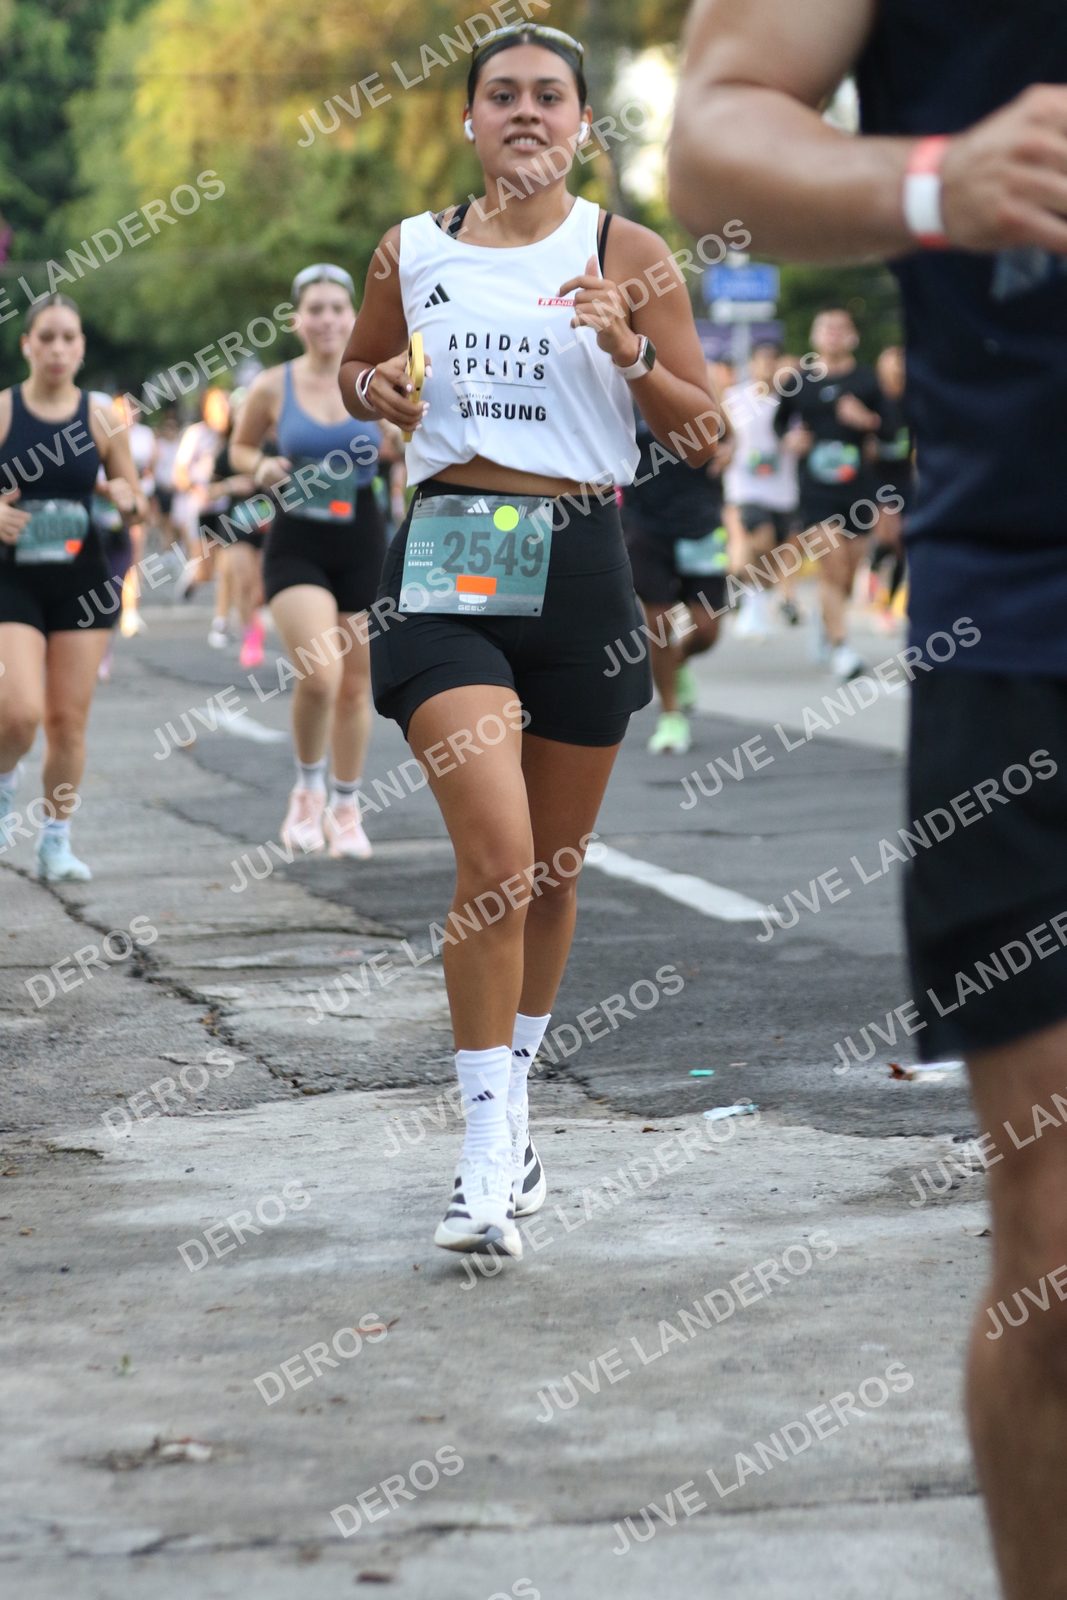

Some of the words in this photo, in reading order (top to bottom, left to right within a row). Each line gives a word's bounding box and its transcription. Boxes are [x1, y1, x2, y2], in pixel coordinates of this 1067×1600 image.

[449, 332, 550, 356] ADIDAS
[453, 358, 545, 380] SPLITS
[459, 400, 547, 421] SAMSUNG
[441, 530, 544, 577] 2549
